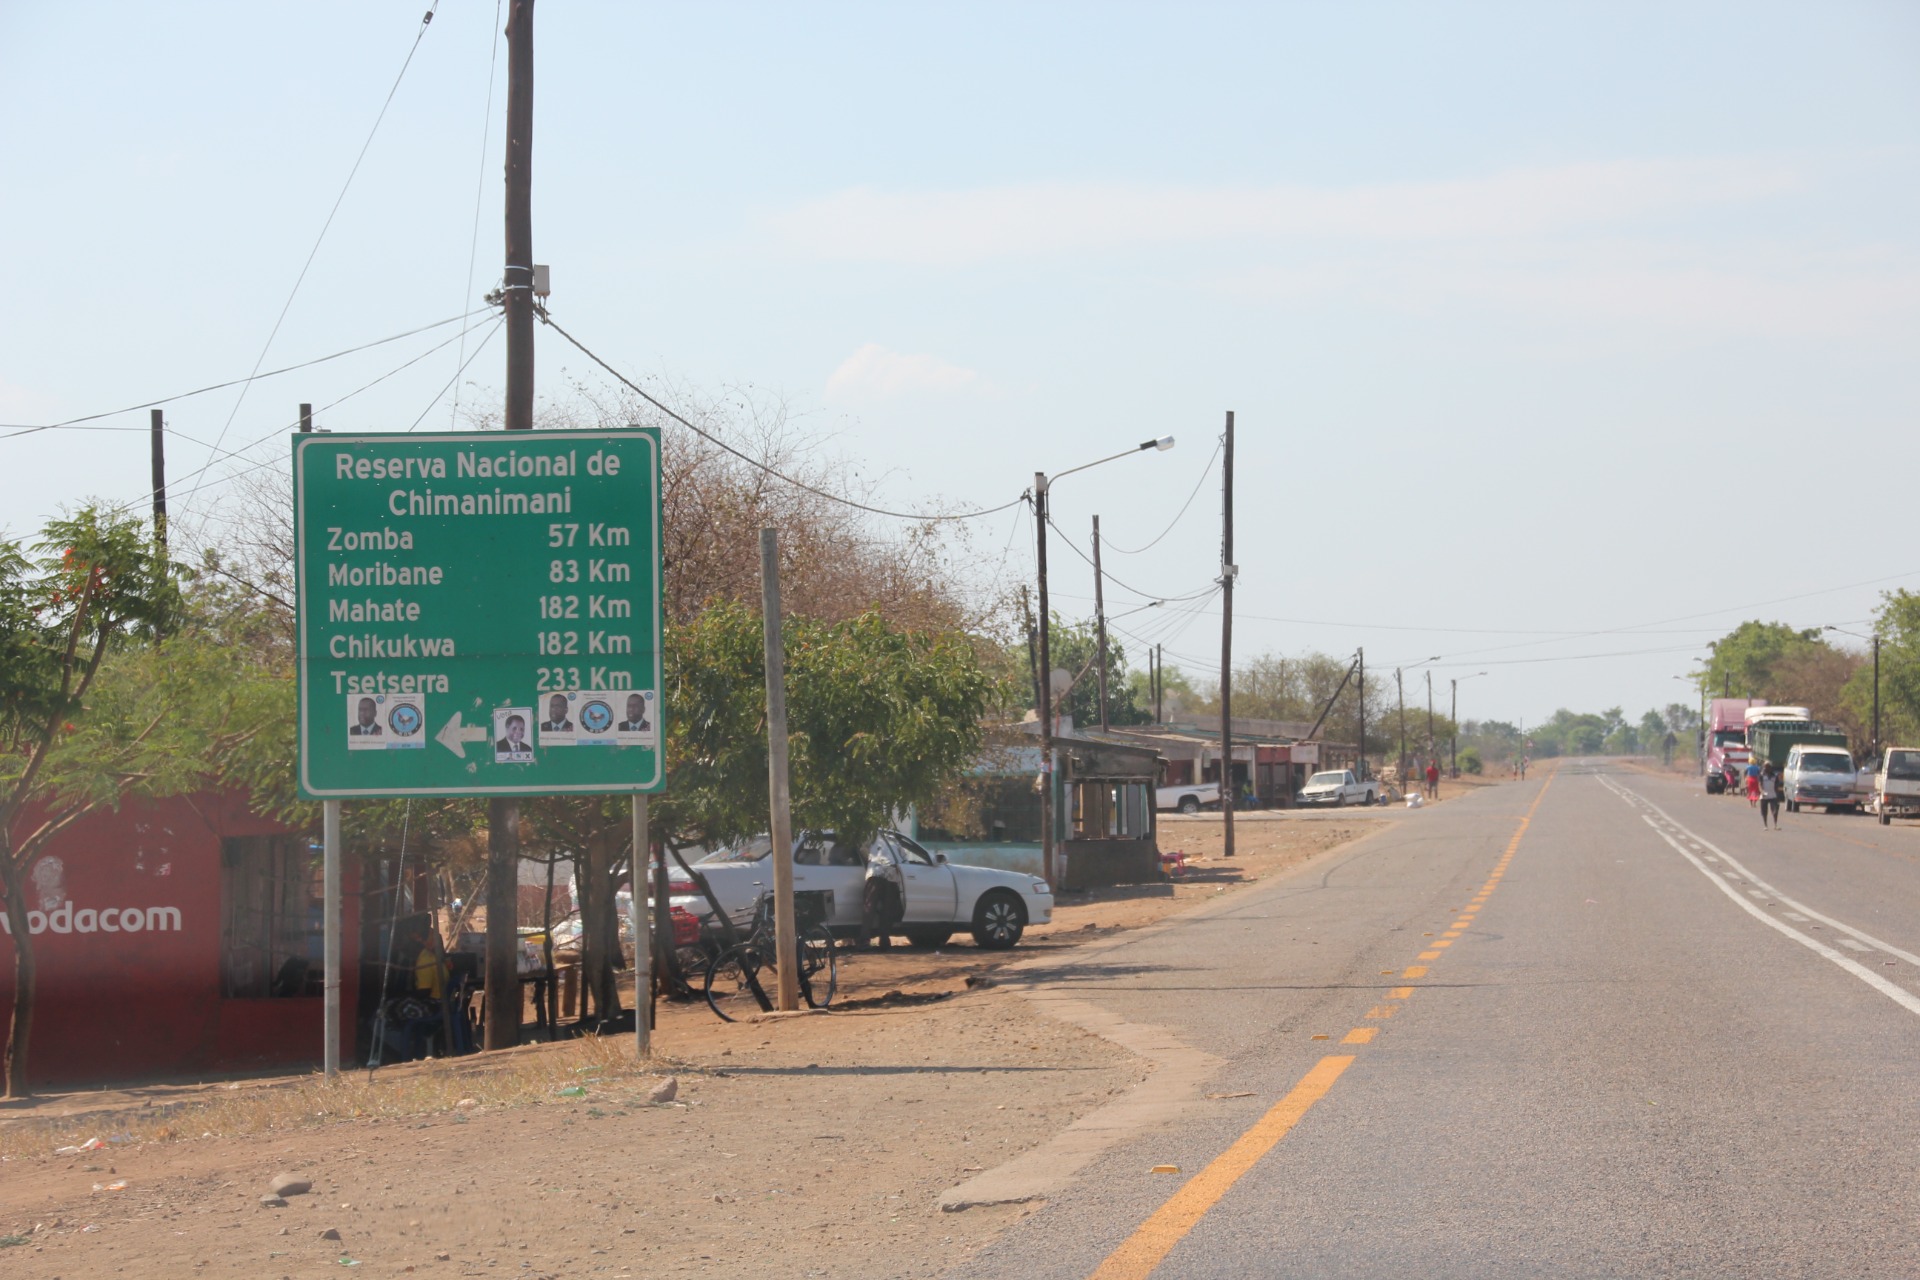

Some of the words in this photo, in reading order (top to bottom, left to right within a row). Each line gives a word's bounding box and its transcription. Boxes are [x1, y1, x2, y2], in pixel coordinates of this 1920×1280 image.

[336, 453, 446, 480] Reserva
[457, 450, 576, 478] Nacional
[586, 450, 621, 476] de
[388, 486, 571, 516] Chimanimani
[327, 527, 414, 551] Zomba
[548, 524, 580, 548] 57
[588, 523, 630, 547] Km
[328, 562, 444, 587] Moribane
[549, 559, 580, 584] 83
[589, 559, 631, 583] Km
[329, 598, 421, 623] Mahate
[539, 596, 579, 619] 182
[589, 595, 631, 619] Km
[329, 634, 455, 659] Chikukwa
[537, 631, 579, 656] 182
[588, 630, 631, 654] Km
[331, 670, 449, 694] Tsetserra
[536, 667, 581, 691] 233
[590, 667, 632, 690] Km
